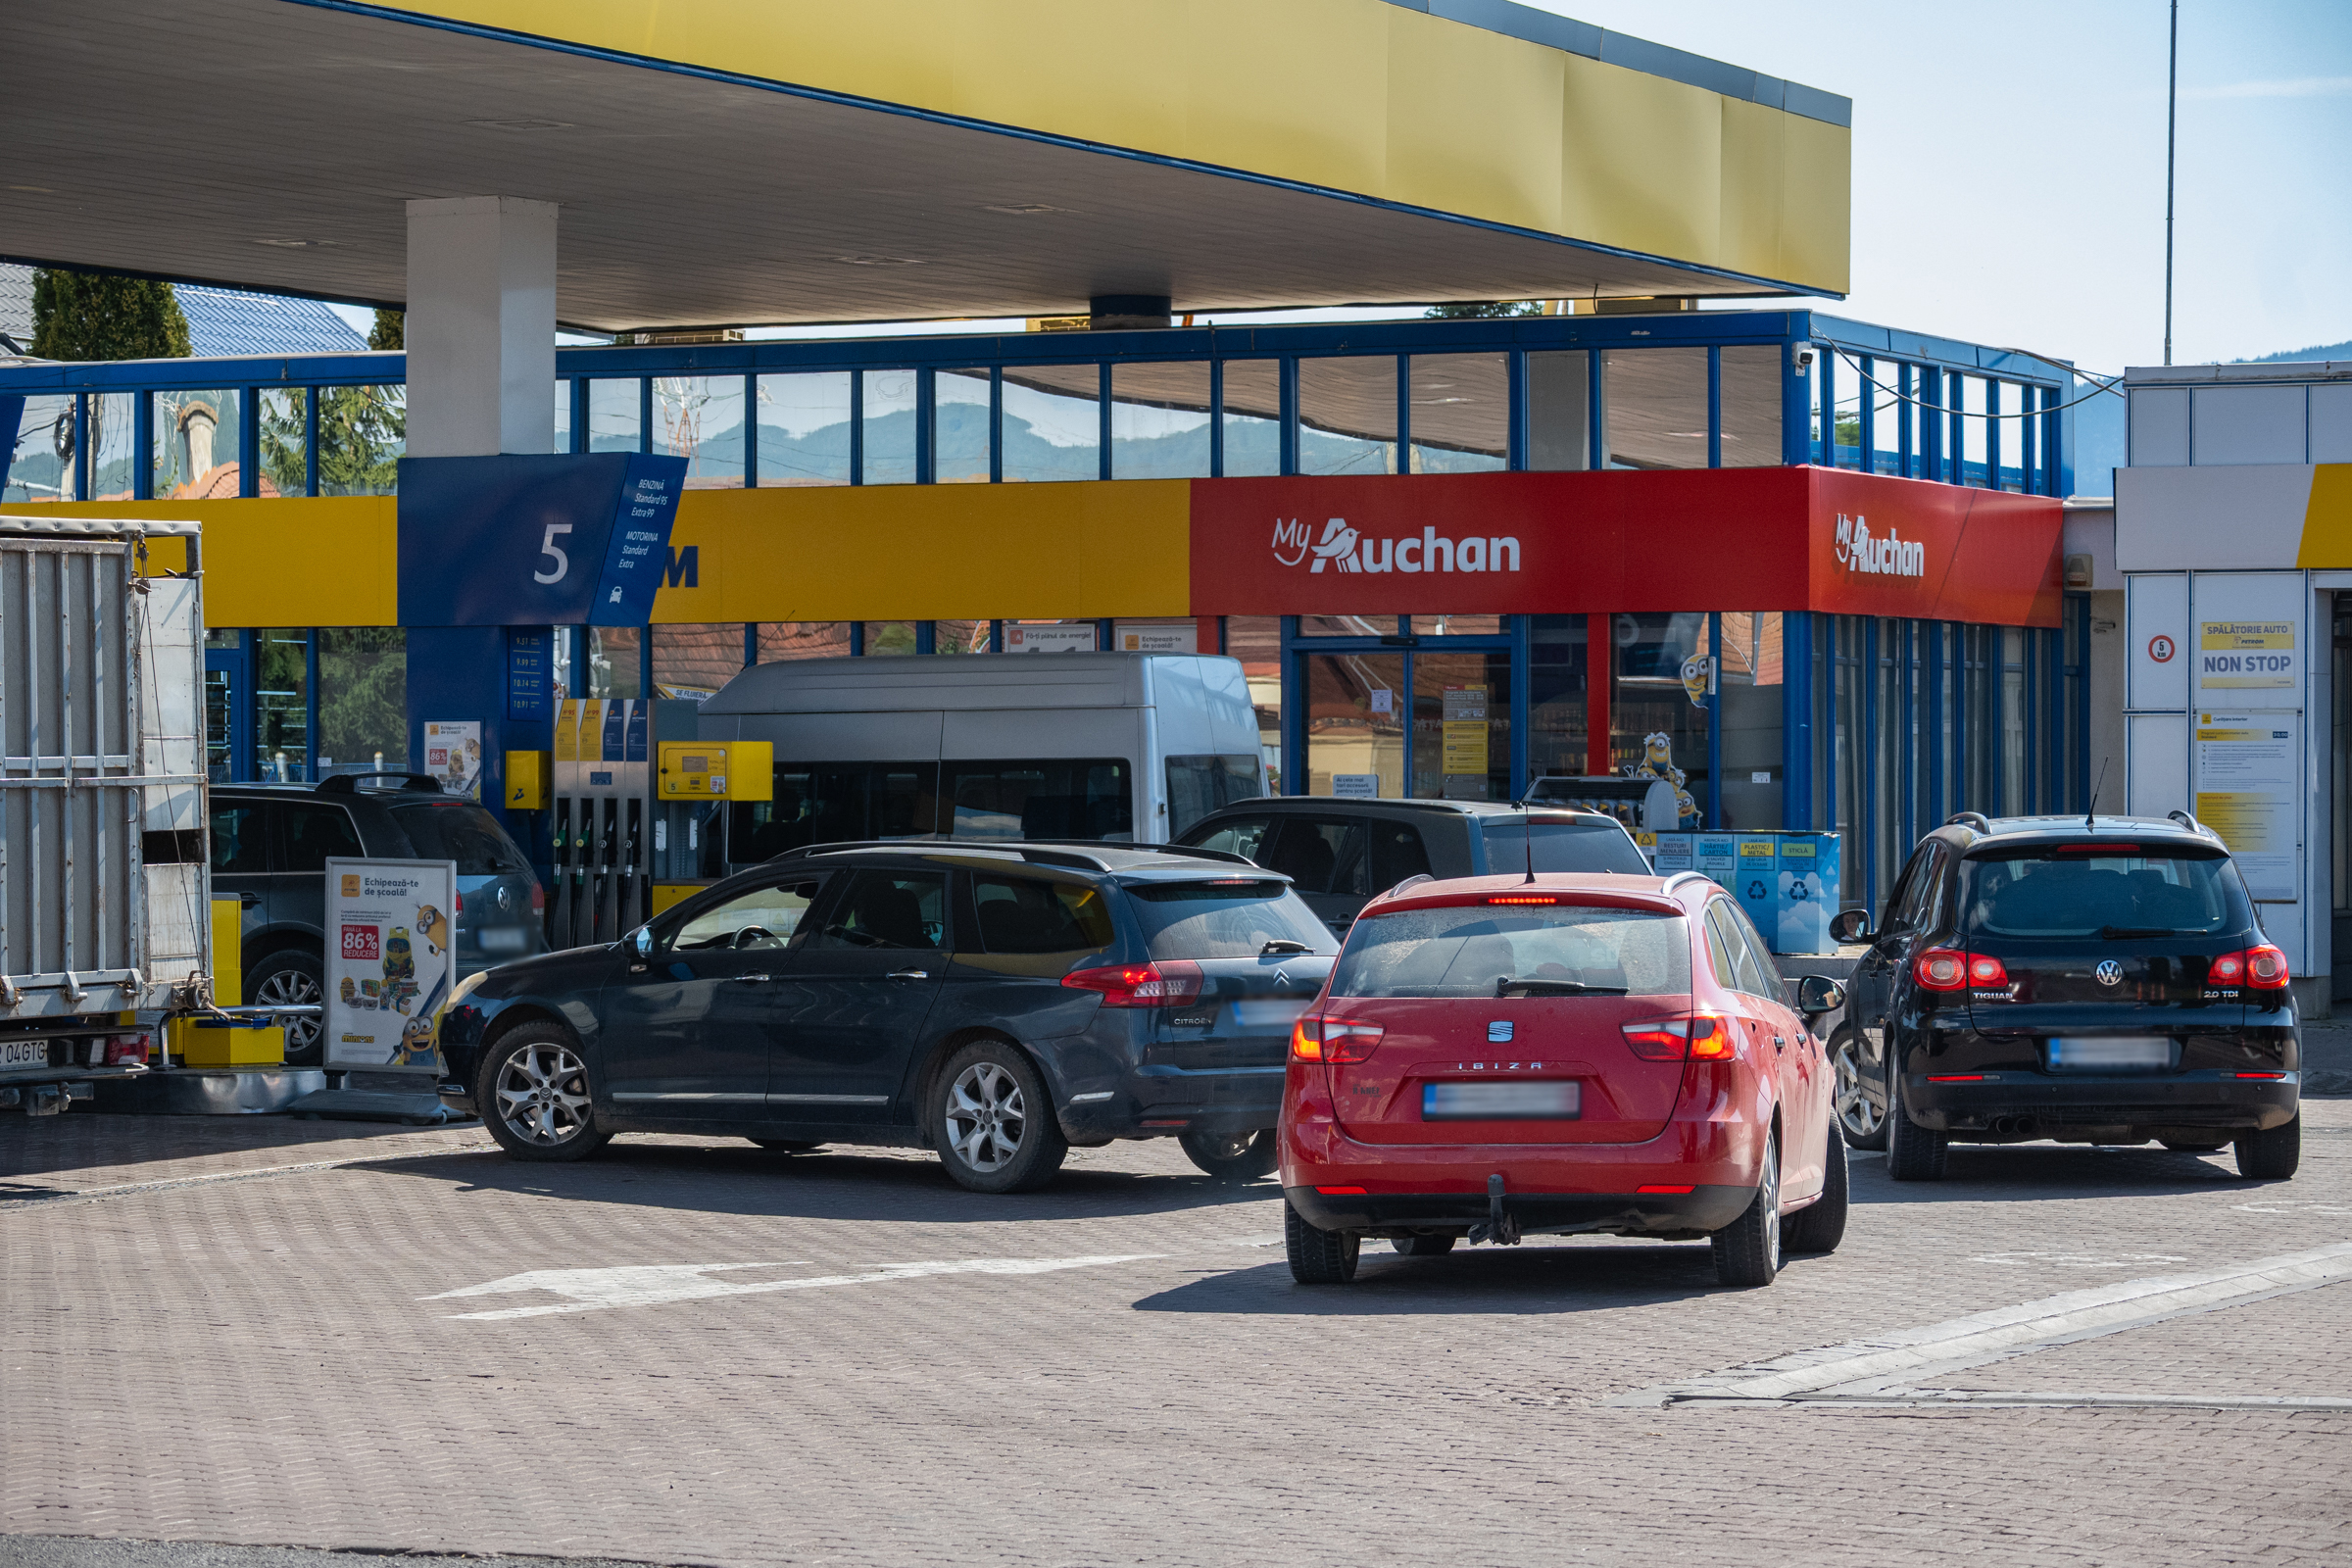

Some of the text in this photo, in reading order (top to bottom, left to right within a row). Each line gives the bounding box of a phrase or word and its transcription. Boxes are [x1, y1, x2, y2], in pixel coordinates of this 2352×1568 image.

[639, 479, 664, 490] BENZINĂ
[635, 493, 667, 506] Standard 95
[631, 507, 655, 517] Extra 99
[622, 545, 649, 556] Standard
[1271, 517, 1520, 573] My Auchan
[1836, 513, 1924, 577] My Auchan
[534, 523, 572, 584] 5
[618, 559, 634, 568] Extra
[2207, 624, 2288, 635] SPĂLĂTORIE AUTO
[2159, 641, 2165, 652] 5
[2204, 656, 2291, 672] NON STOP
[365, 878, 418, 888] Echipează-te
[377, 889, 407, 898] școală!
[343, 932, 378, 950] 86%
[344, 950, 378, 958] REDUCERE
